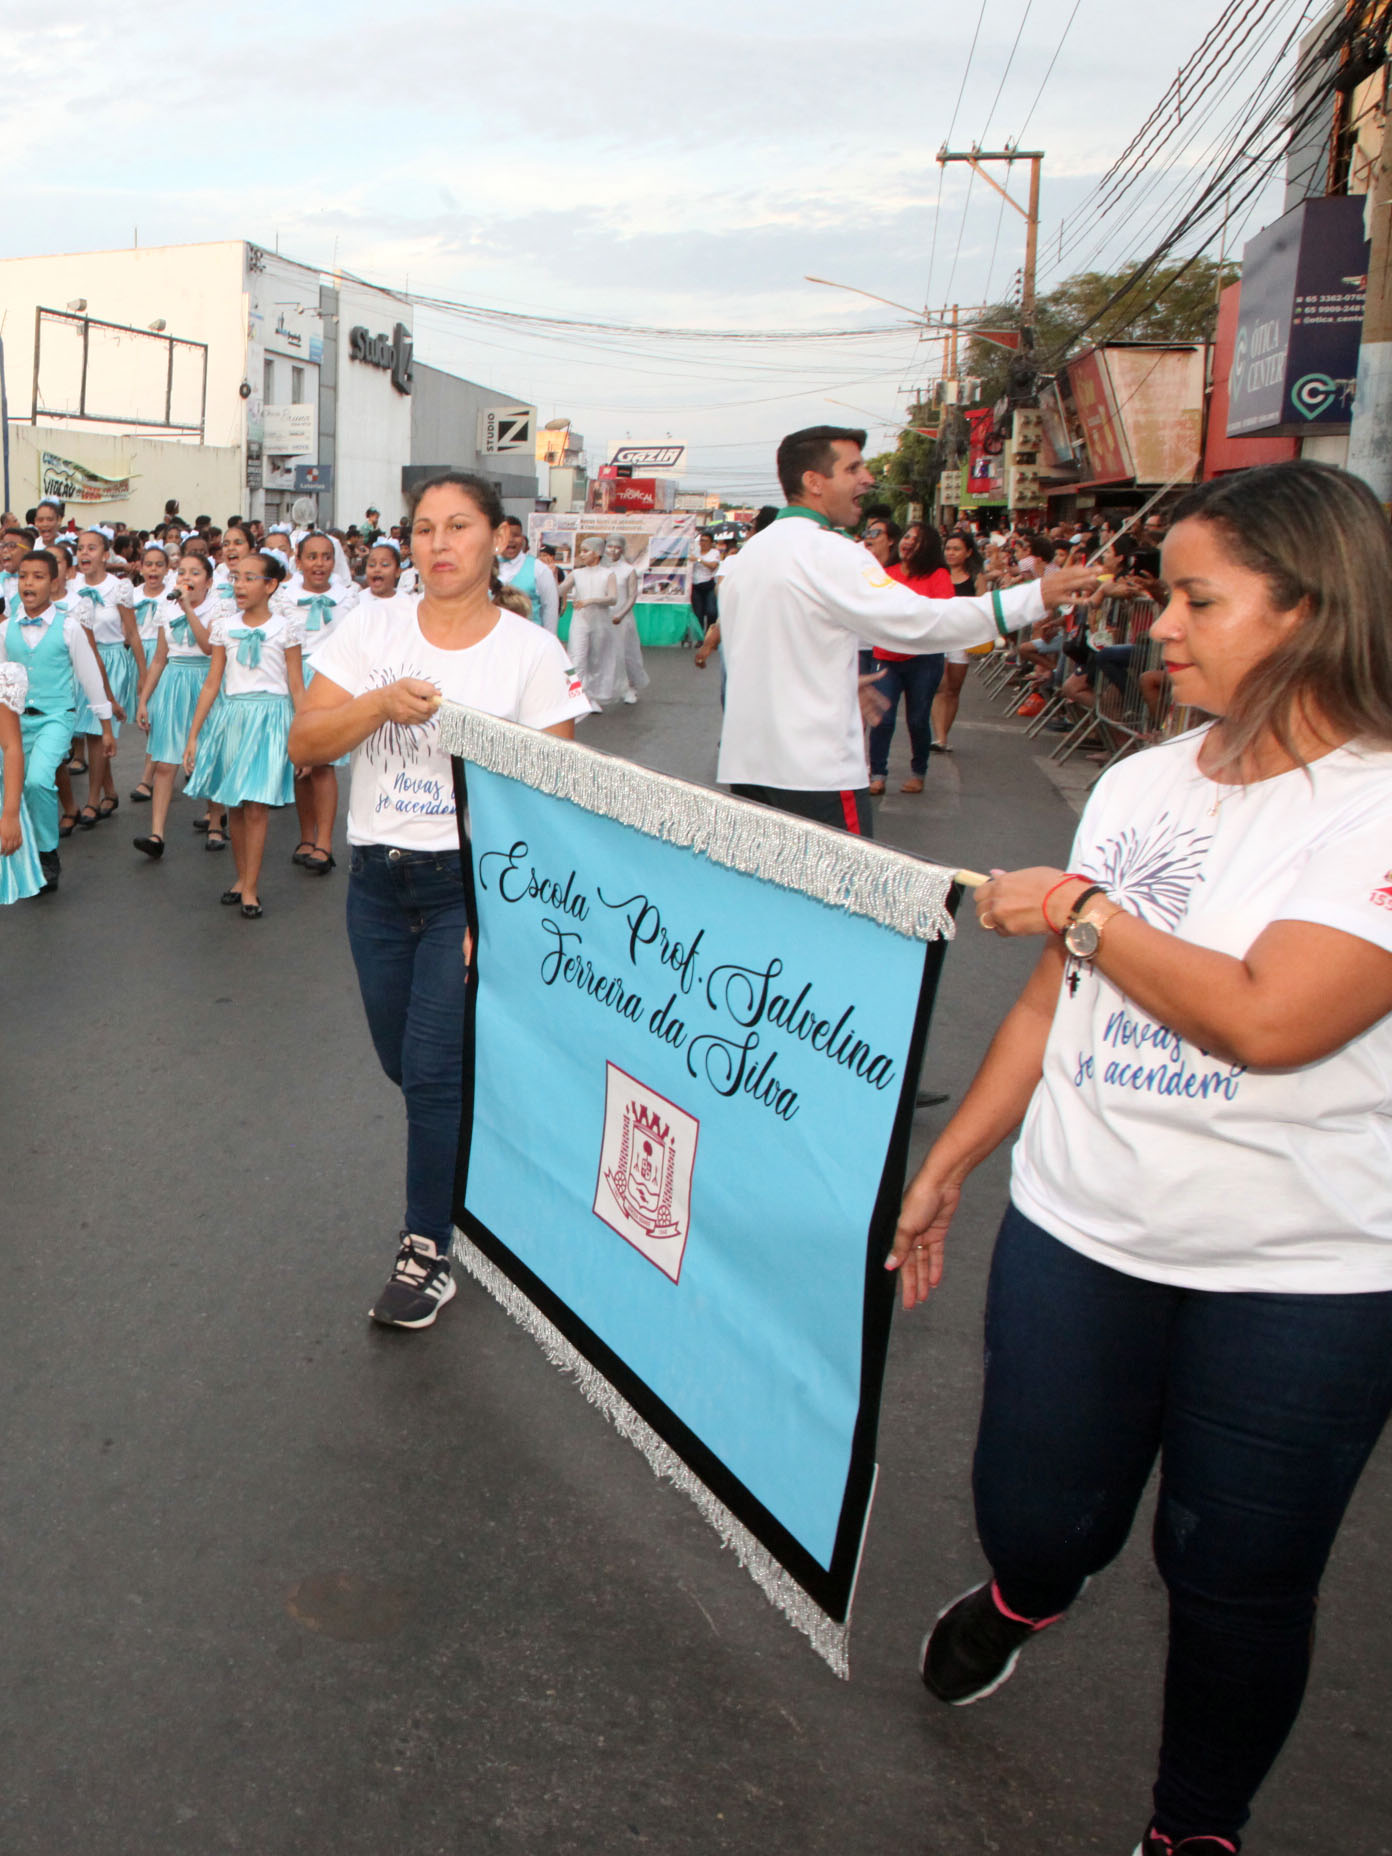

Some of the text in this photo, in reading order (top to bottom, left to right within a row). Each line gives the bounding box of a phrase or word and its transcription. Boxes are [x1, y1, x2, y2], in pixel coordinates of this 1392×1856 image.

[1248, 350, 1287, 392] CENTER
[487, 413, 495, 452] STUDIO
[617, 448, 682, 465] GAZIN
[376, 794, 390, 812] se
[393, 772, 445, 796] Novas
[479, 841, 895, 1091] Escola Prof. Salvelina
[540, 918, 800, 1122] Ferreira da Silva
[1103, 1010, 1184, 1063] Novas
[1074, 1050, 1094, 1087] se
[1104, 1061, 1239, 1101] acendem
